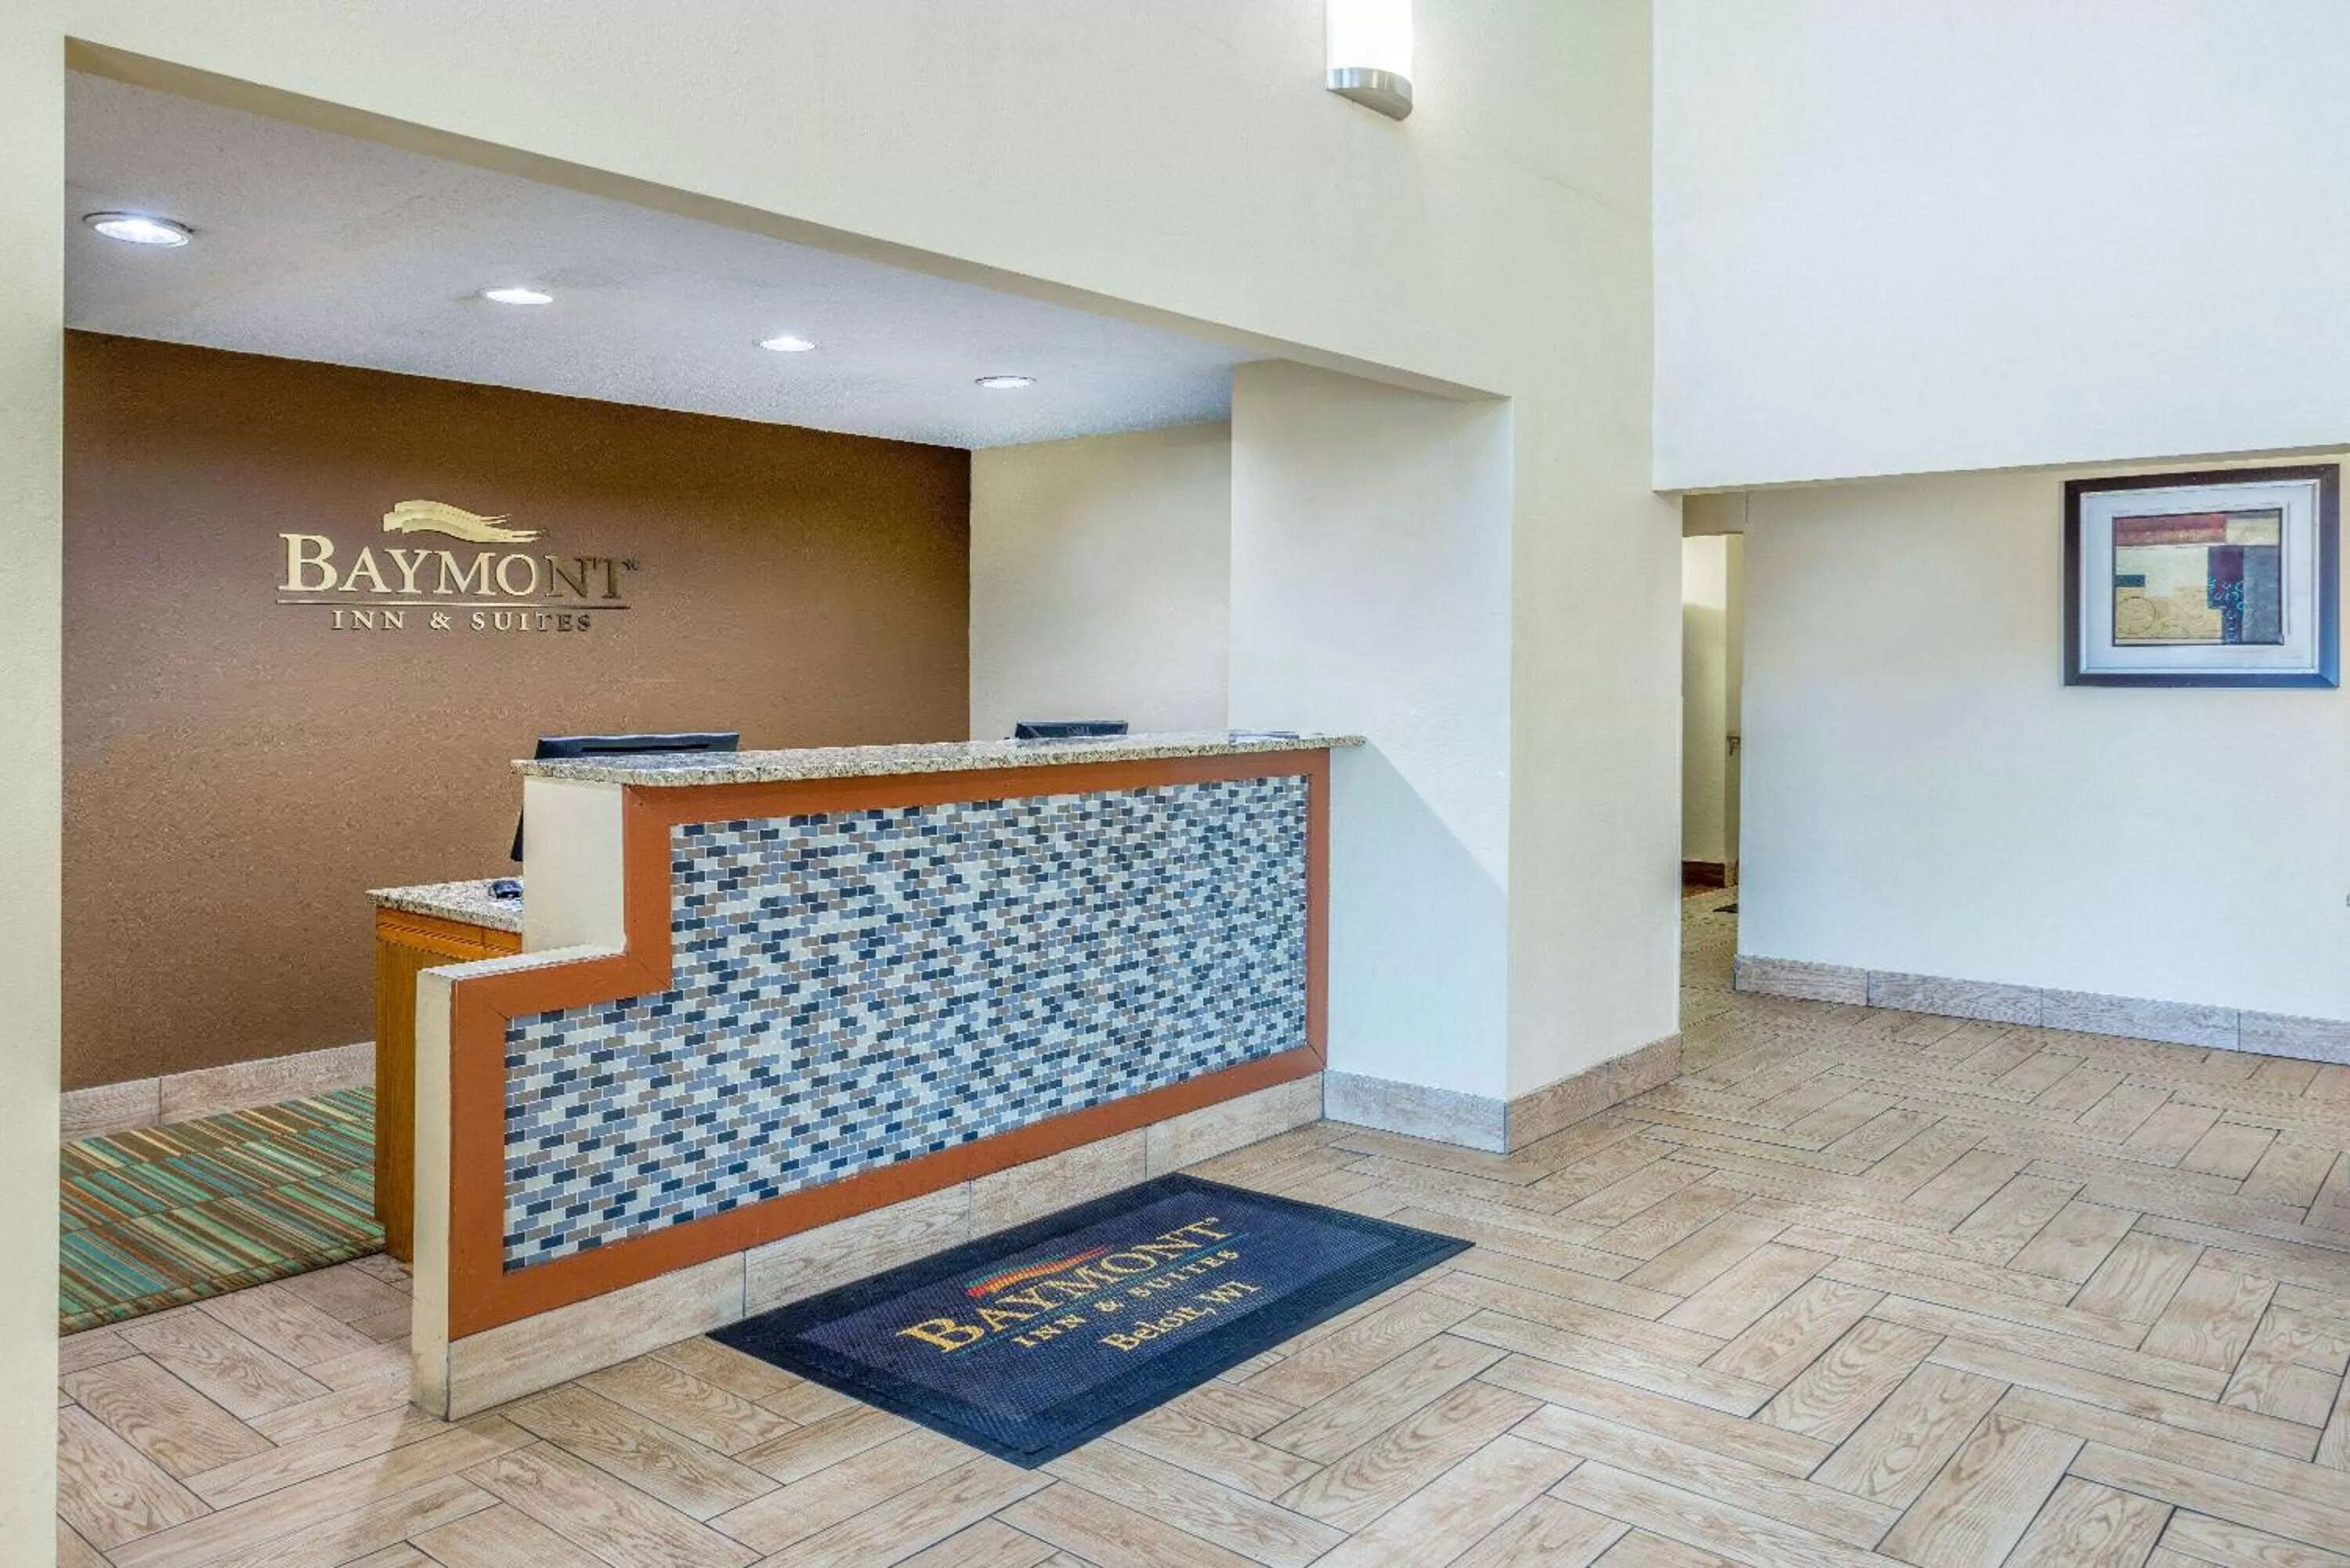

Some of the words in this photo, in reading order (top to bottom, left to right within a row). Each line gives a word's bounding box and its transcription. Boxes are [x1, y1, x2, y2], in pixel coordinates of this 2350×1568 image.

[331, 609, 406, 630] INN
[429, 611, 452, 631] &
[471, 611, 592, 632] SUITES
[1011, 1313, 1087, 1348] INN
[1094, 1296, 1125, 1313] &
[1126, 1249, 1239, 1299] SUITES
[1196, 1280, 1261, 1304] WI
